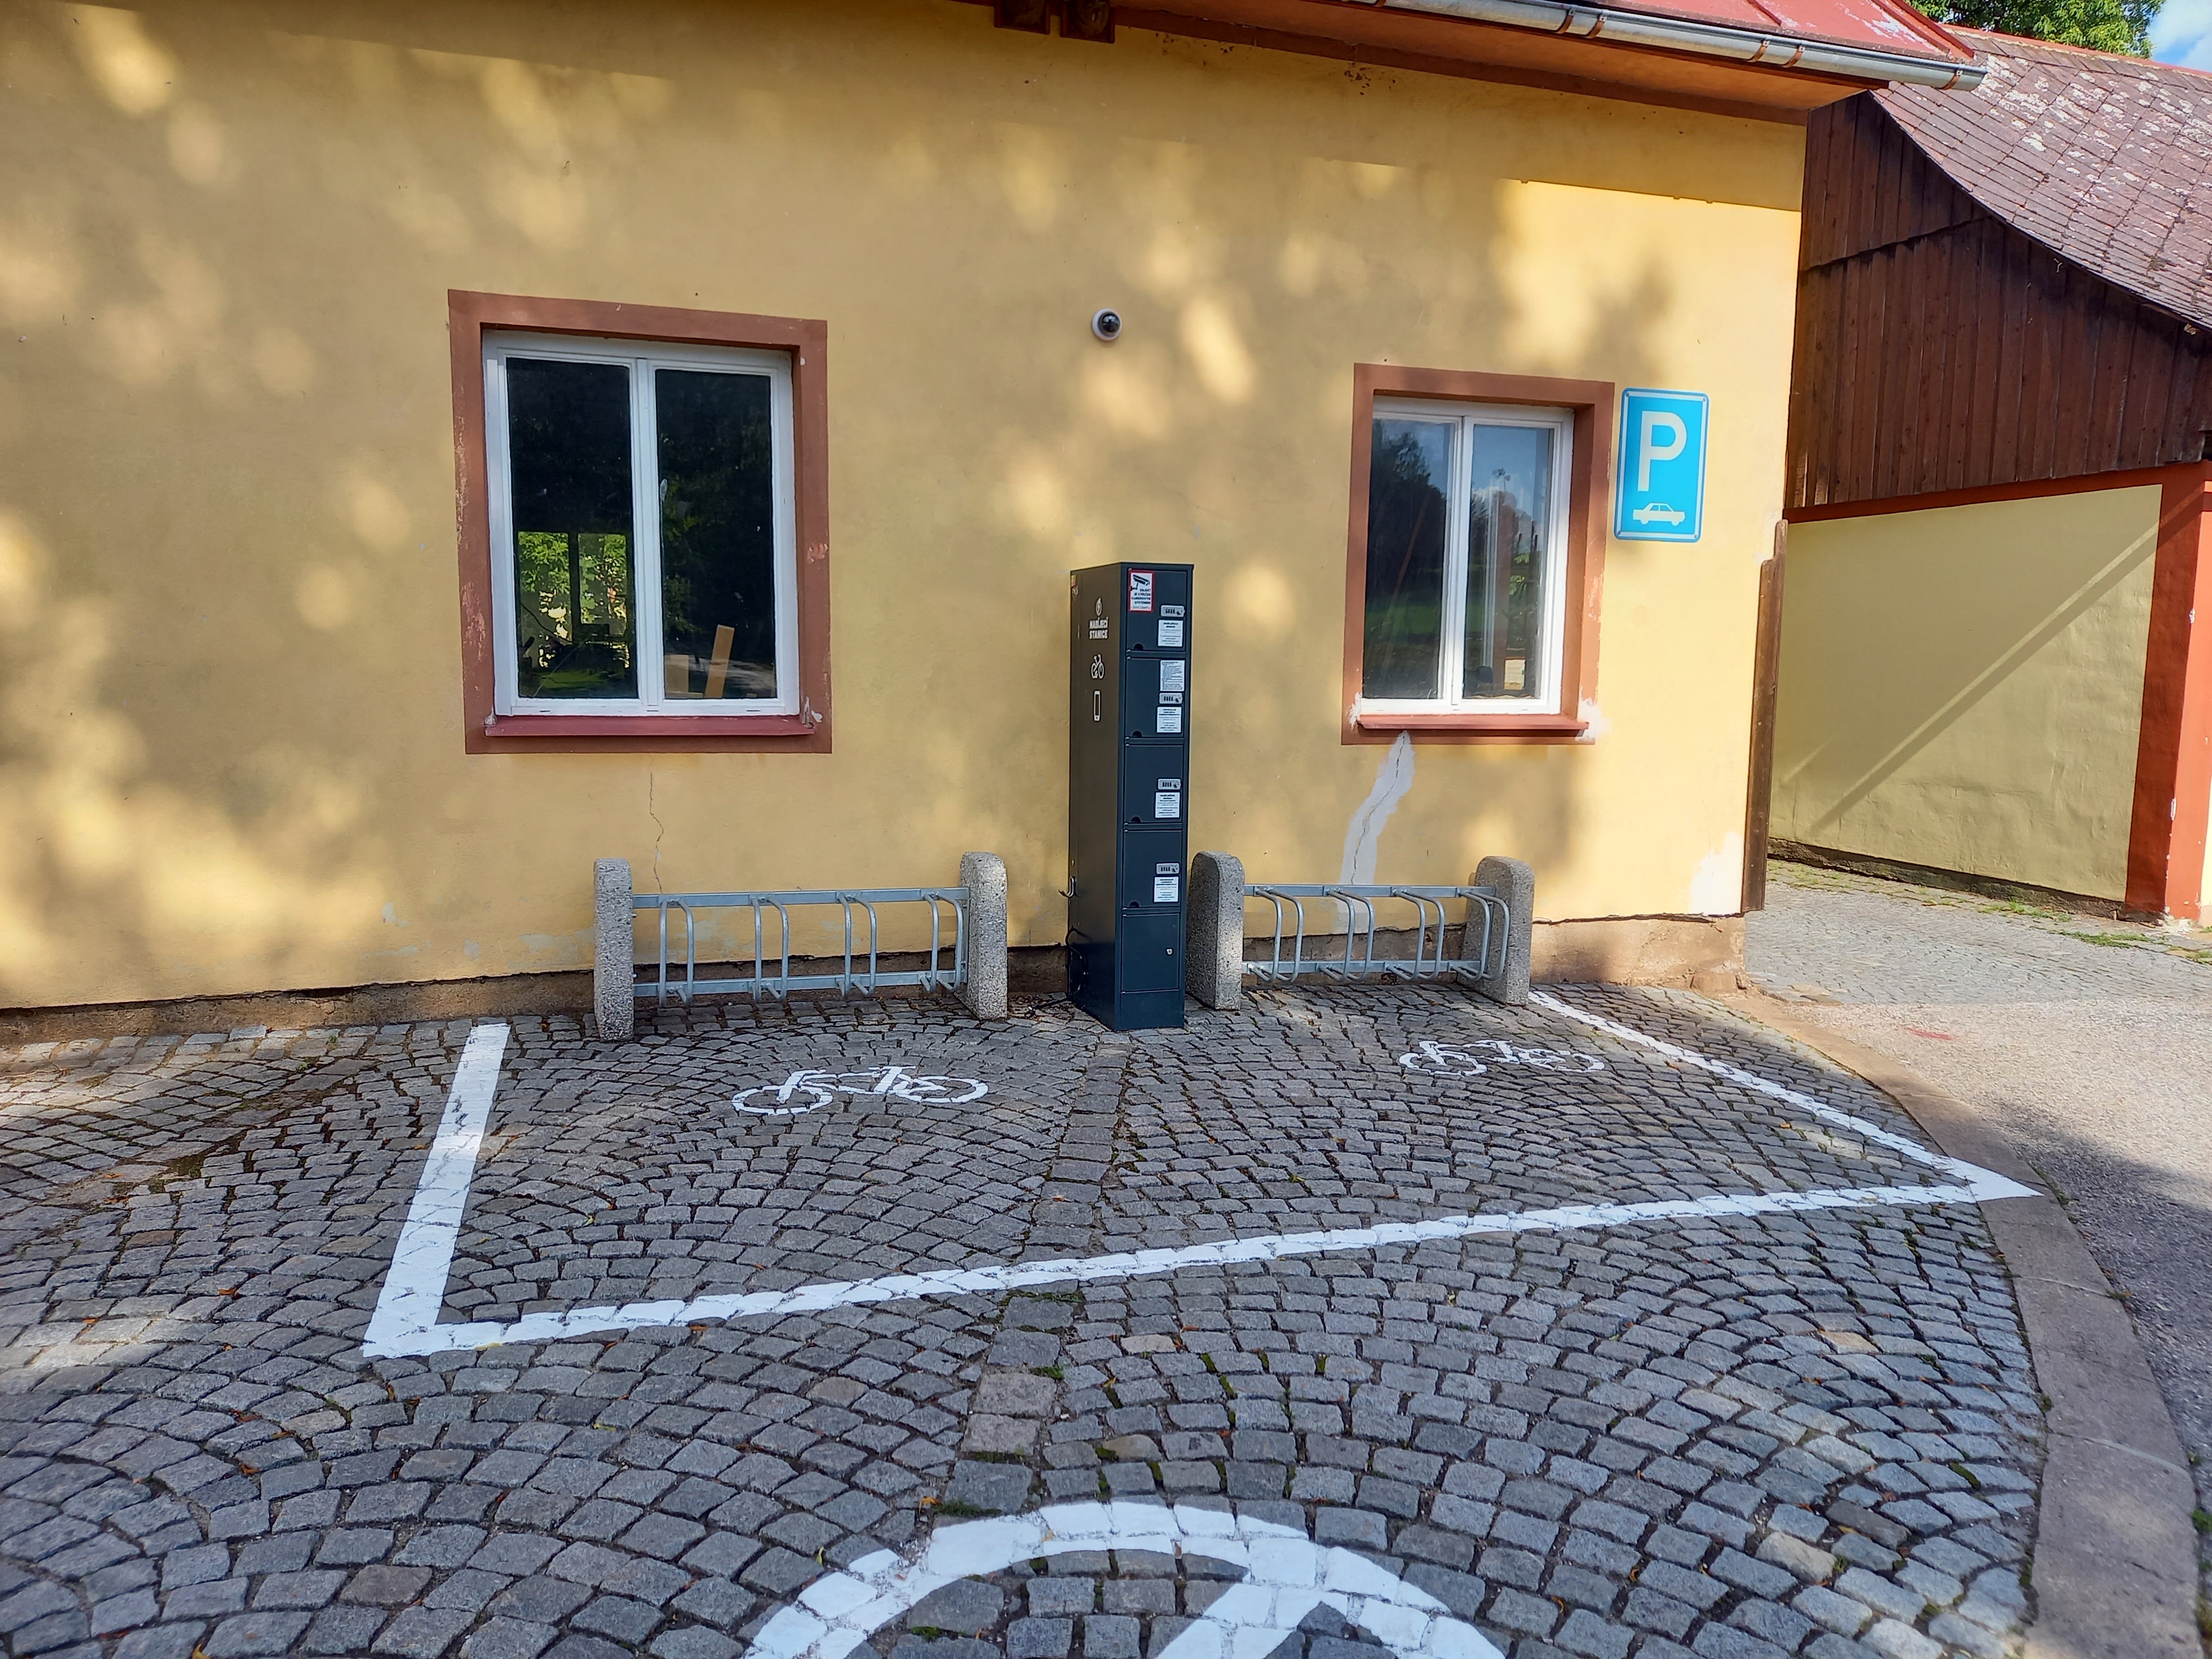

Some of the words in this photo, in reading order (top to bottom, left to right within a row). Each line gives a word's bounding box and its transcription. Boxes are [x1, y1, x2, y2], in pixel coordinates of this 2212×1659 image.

[1637, 410, 1687, 492] P
[1089, 617, 1109, 629] NABÍJECÍ
[1089, 629, 1108, 639] STANICE
